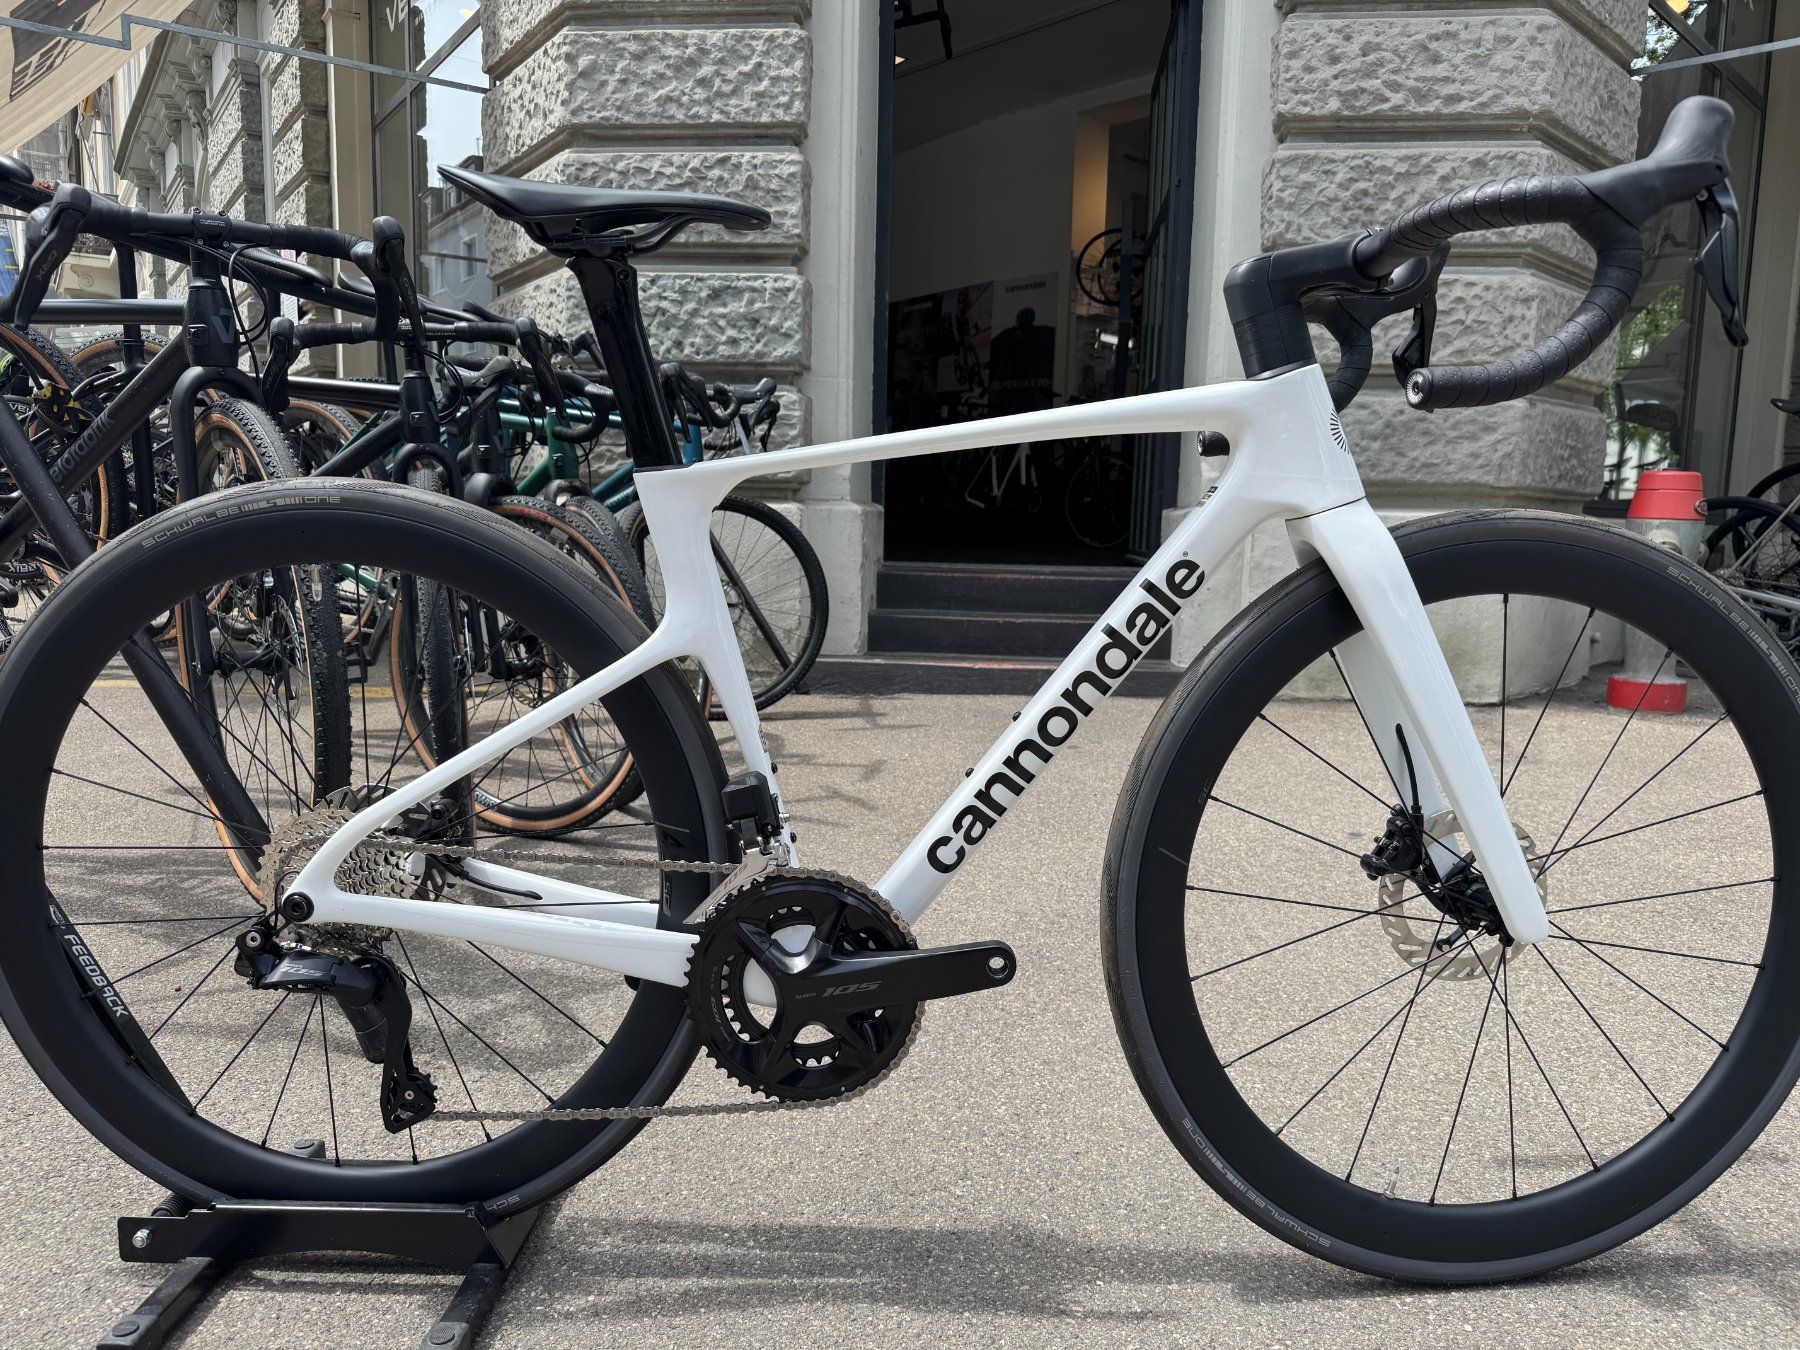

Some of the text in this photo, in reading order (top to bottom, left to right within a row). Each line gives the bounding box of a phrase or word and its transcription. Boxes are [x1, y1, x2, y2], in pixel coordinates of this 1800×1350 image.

[142, 496, 341, 548] SCHWALBE ONE
[1666, 566, 1750, 631] SCHWALBE
[926, 558, 1206, 874] cannondale
[63, 934, 129, 1018] FEEDBACK
[822, 981, 884, 997] 105
[1182, 1117, 1332, 1248] SCHWALBE ONE
